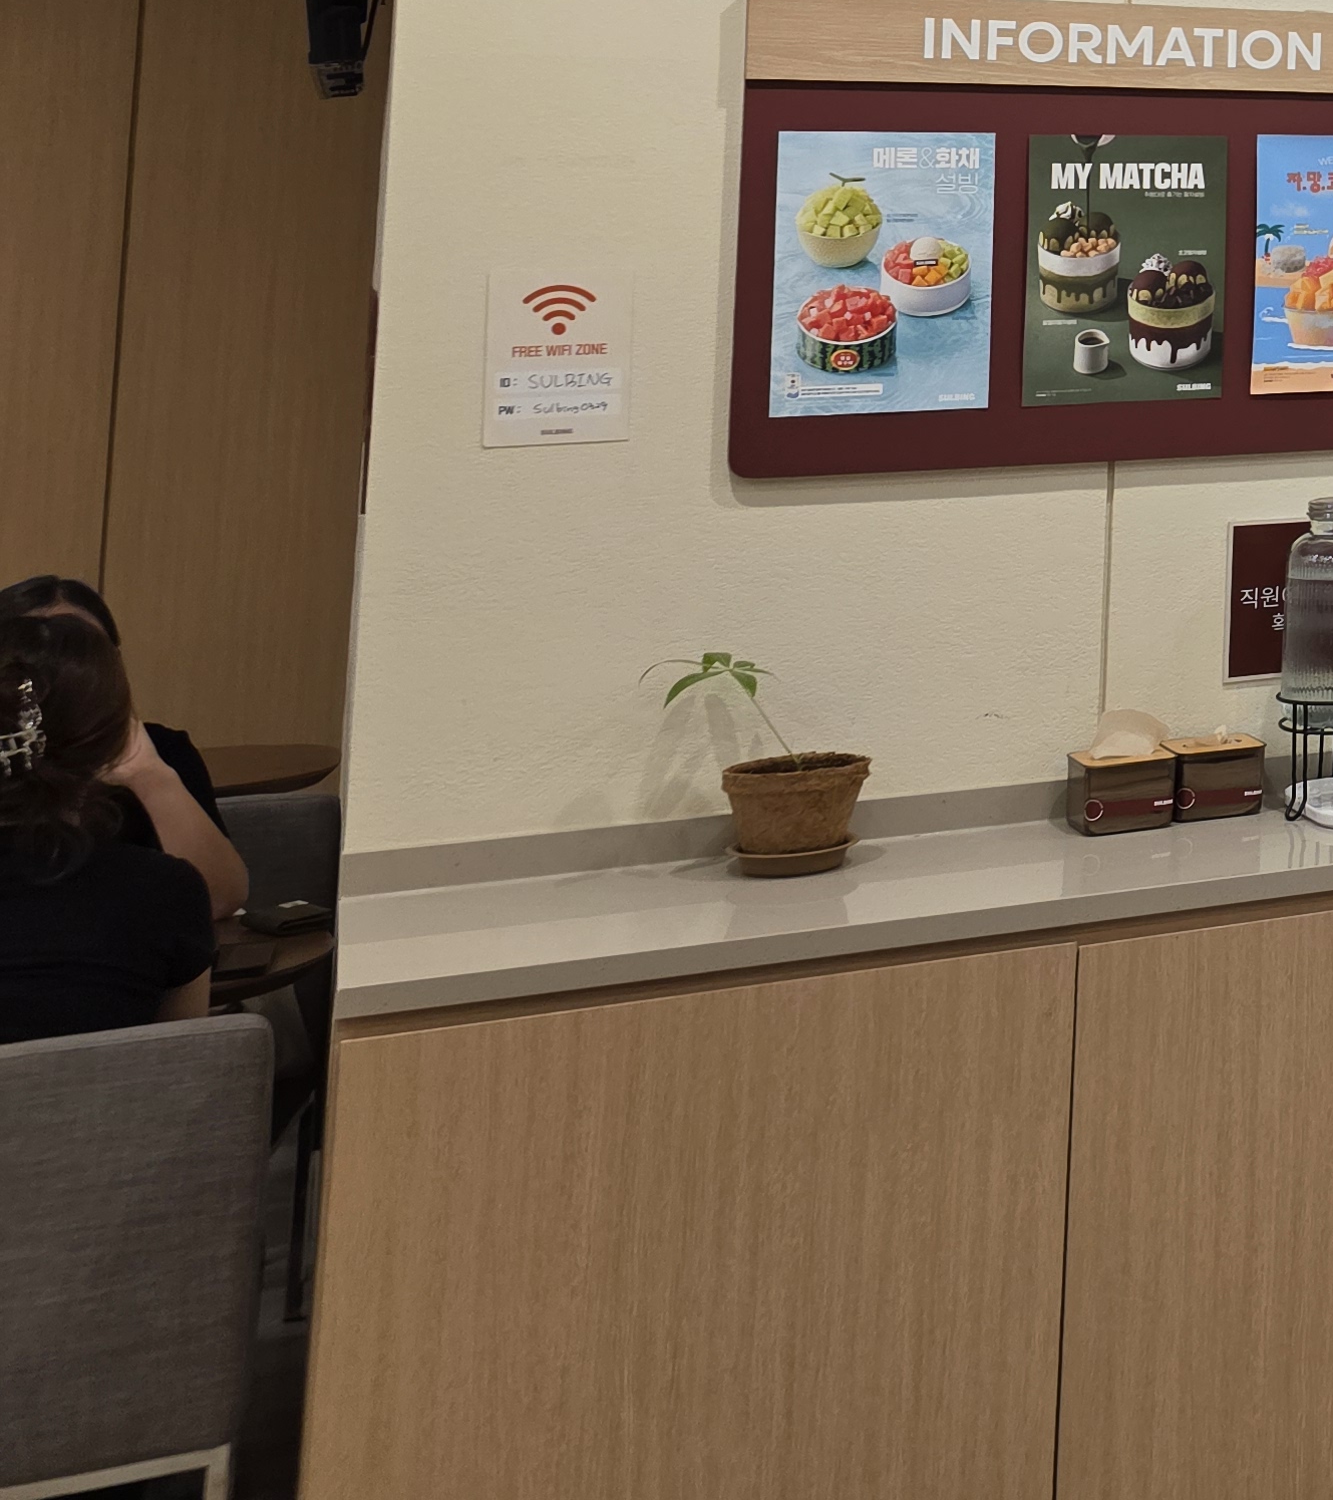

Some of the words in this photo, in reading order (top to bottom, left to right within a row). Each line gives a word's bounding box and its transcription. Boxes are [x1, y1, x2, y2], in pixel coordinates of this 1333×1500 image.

[922, 17, 1323, 72] INFORMATION
[872, 147, 980, 169] 메론&화채
[935, 173, 979, 195] 설빙
[1051, 162, 1093, 190] MY
[1099, 162, 1206, 190] MATCHA
[512, 345, 543, 358] FREE
[546, 344, 572, 357] WIFI
[575, 343, 608, 356] ZONE
[527, 372, 613, 389] SULBING
